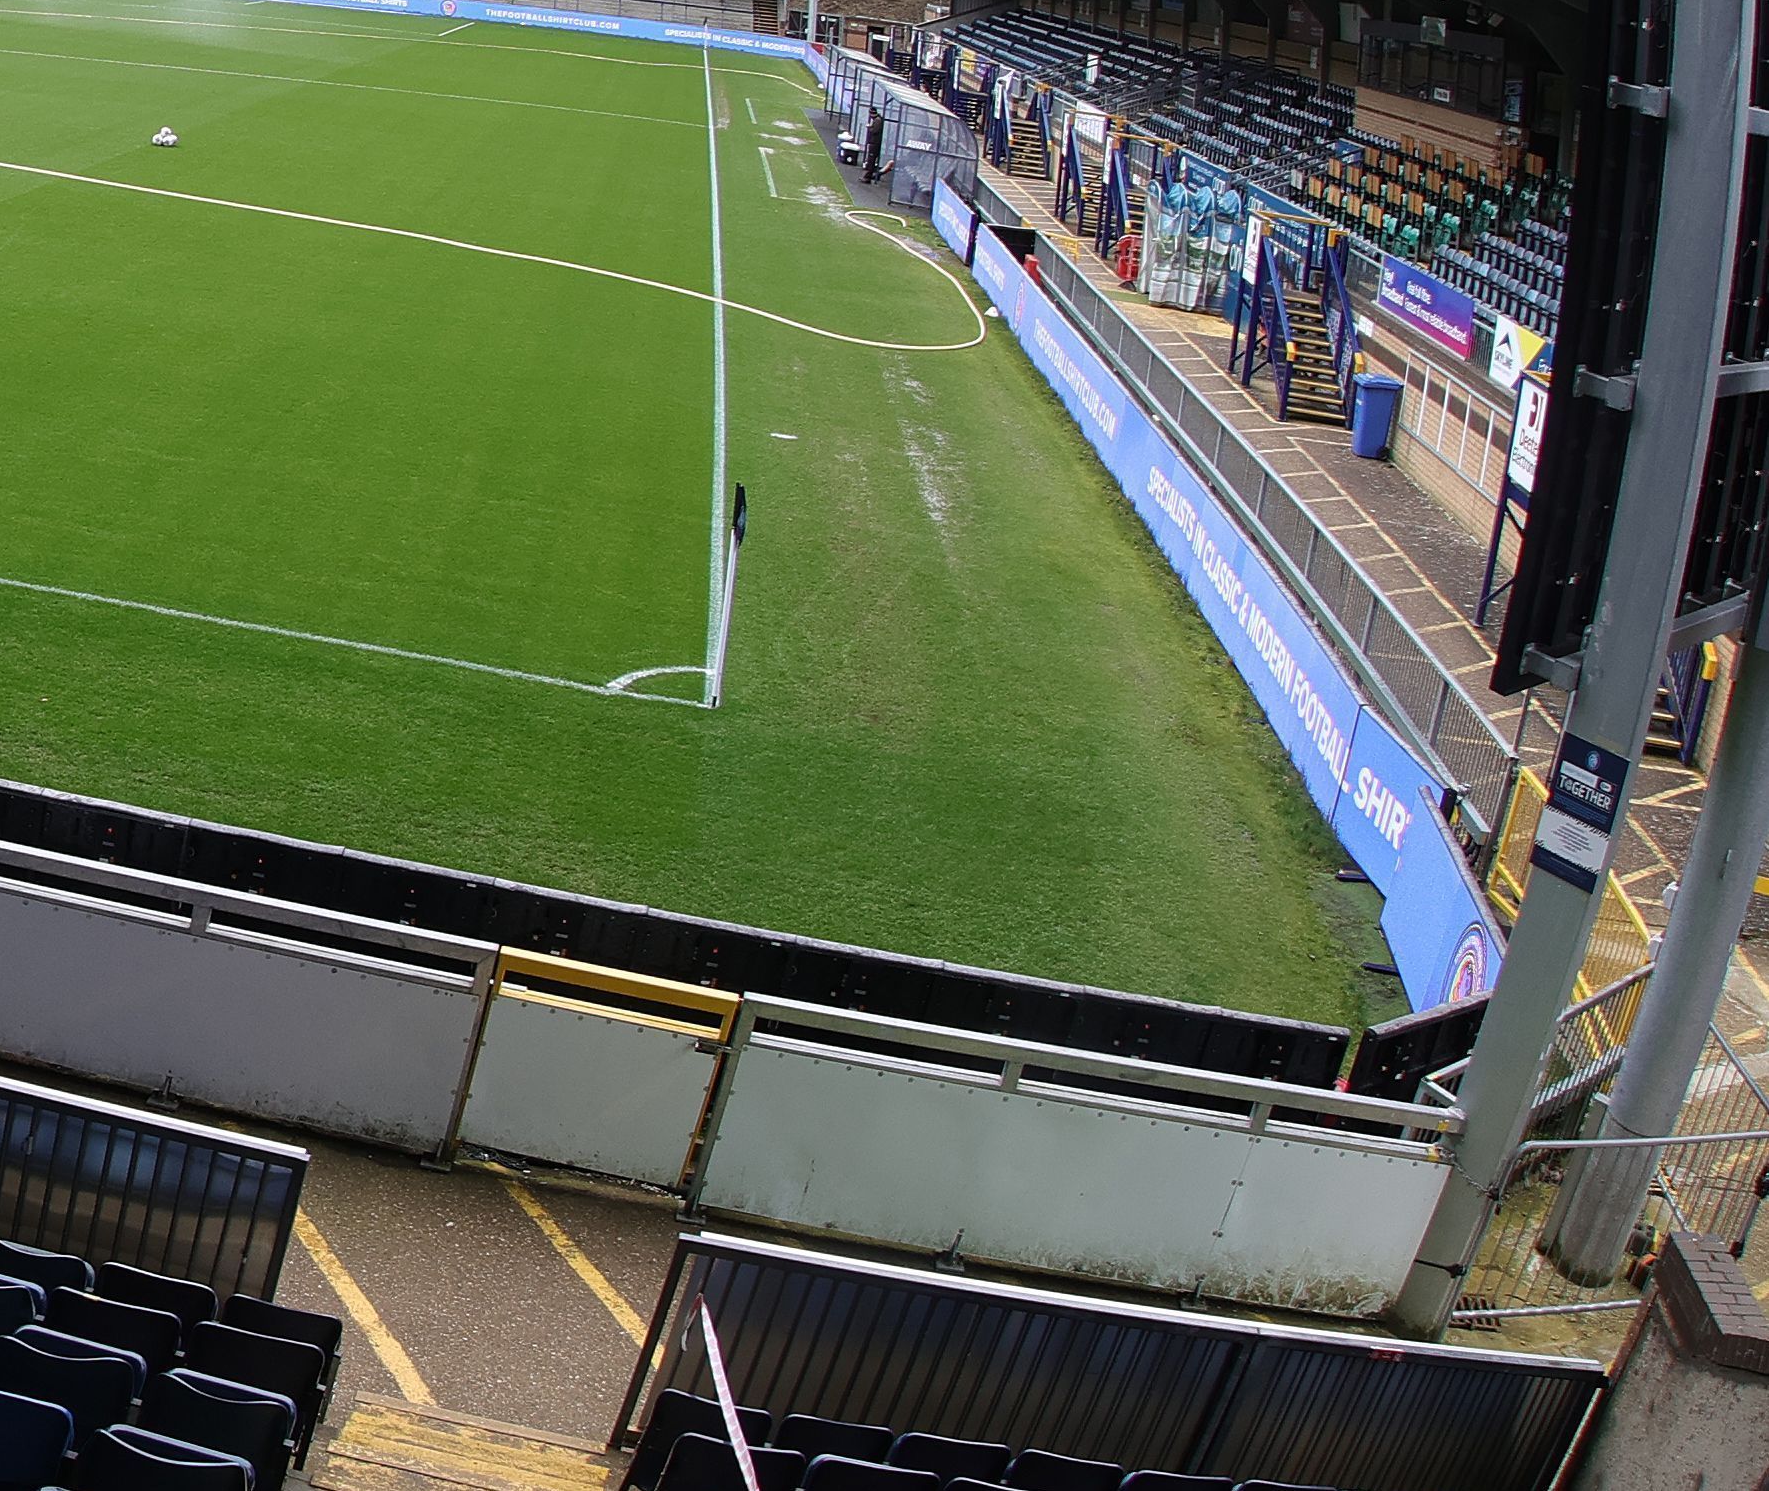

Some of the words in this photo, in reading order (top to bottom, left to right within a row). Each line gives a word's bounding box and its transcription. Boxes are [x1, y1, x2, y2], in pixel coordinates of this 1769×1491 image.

[485, 9, 620, 30] THEFOOTBALLSHIRTCLUB.COM
[665, 29, 711, 40] SPECIALISTS
[713, 33, 721, 42] IN
[722, 36, 754, 47] CLASSIC
[905, 139, 932, 151] AWAY
[1033, 317, 1118, 442] THEFOOTBALLSHIRTCLUB.COM
[1147, 466, 1198, 541] SPECIALISTS
[1192, 521, 1207, 559] IN
[1202, 540, 1242, 614] CLASSIC
[1238, 592, 1250, 628] &
[1246, 603, 1296, 696] MODERN
[1289, 671, 1351, 794] FOOTBALL
[1353, 767, 1412, 850] SHIR
